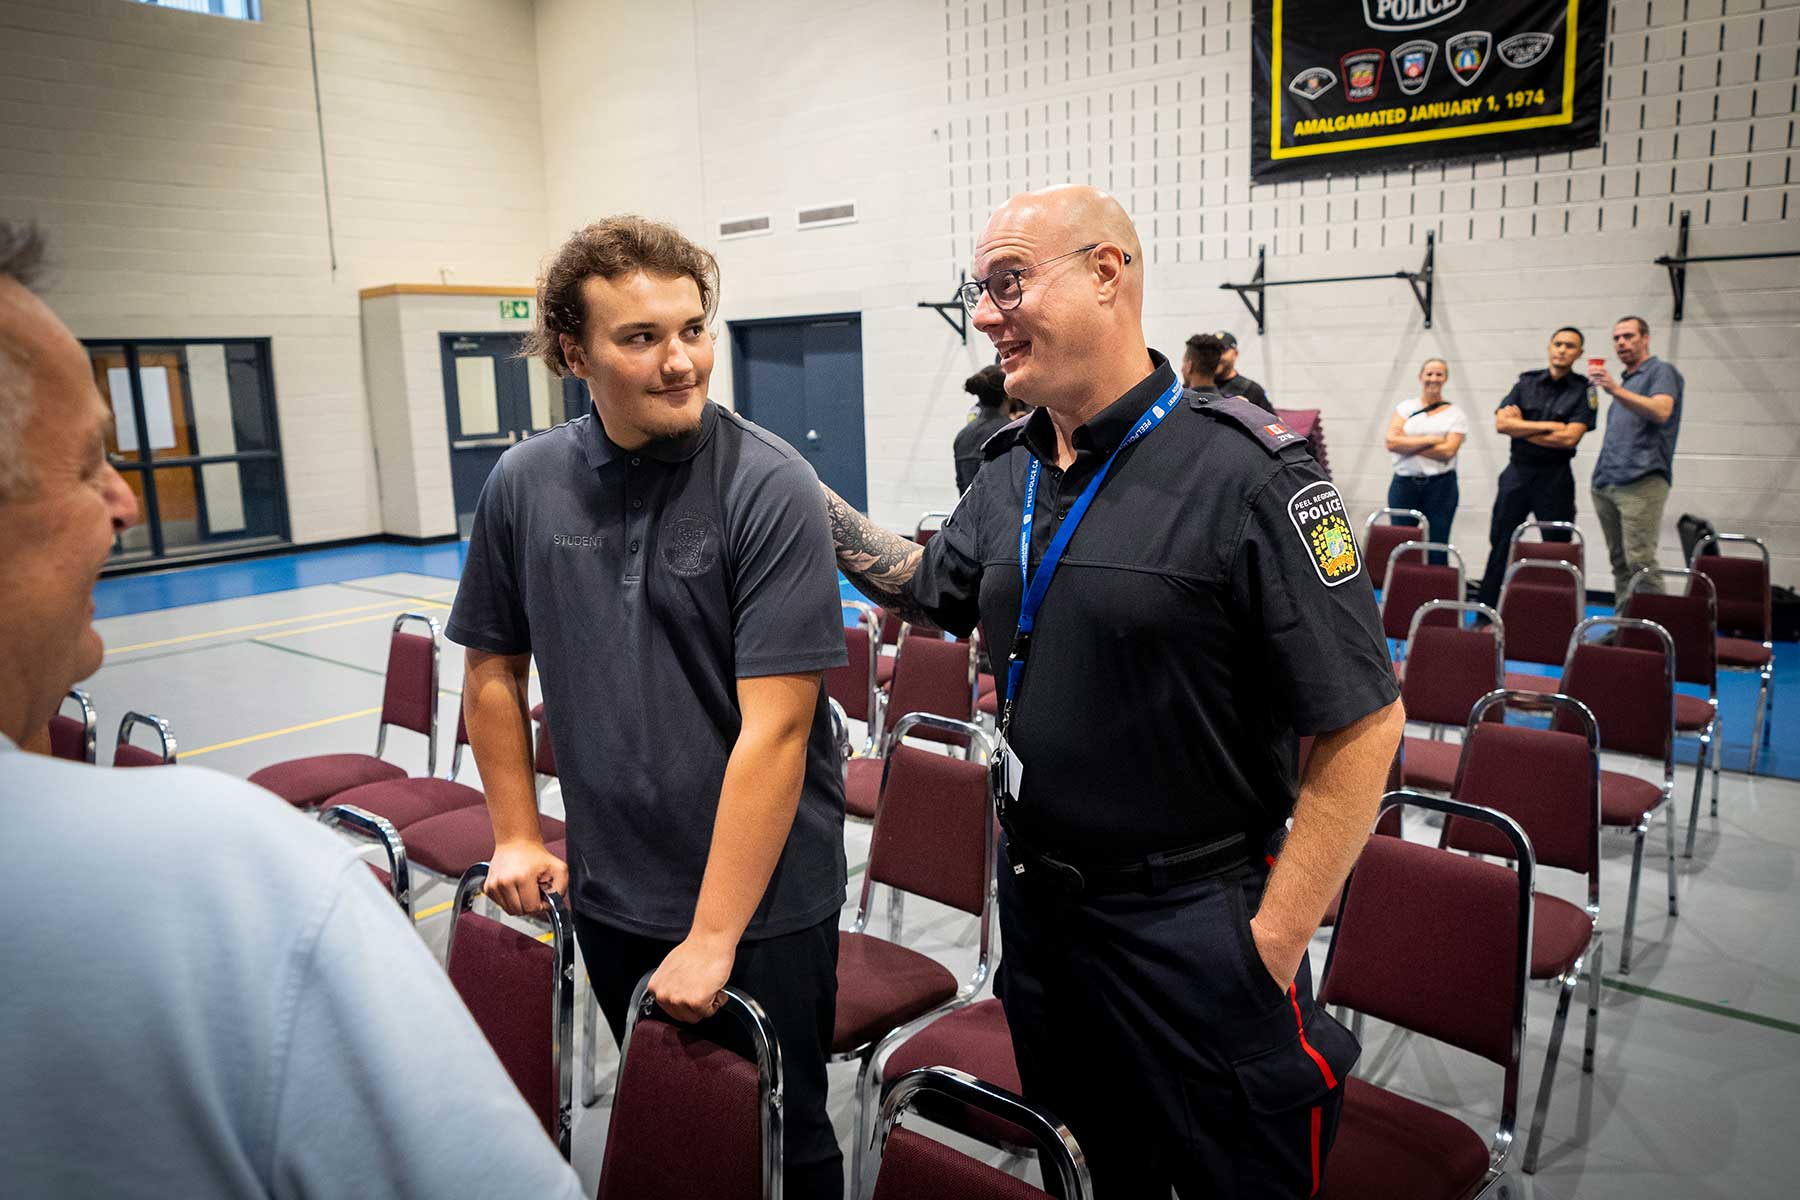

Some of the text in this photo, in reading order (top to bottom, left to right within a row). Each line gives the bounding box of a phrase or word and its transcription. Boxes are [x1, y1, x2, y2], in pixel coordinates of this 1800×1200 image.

[1294, 88, 1545, 136] AMALGAMATED JANUARY 1, 1974
[1294, 499, 1313, 511] PEEL
[1298, 498, 1342, 525] POLICE
[553, 533, 605, 548] STUDENT
